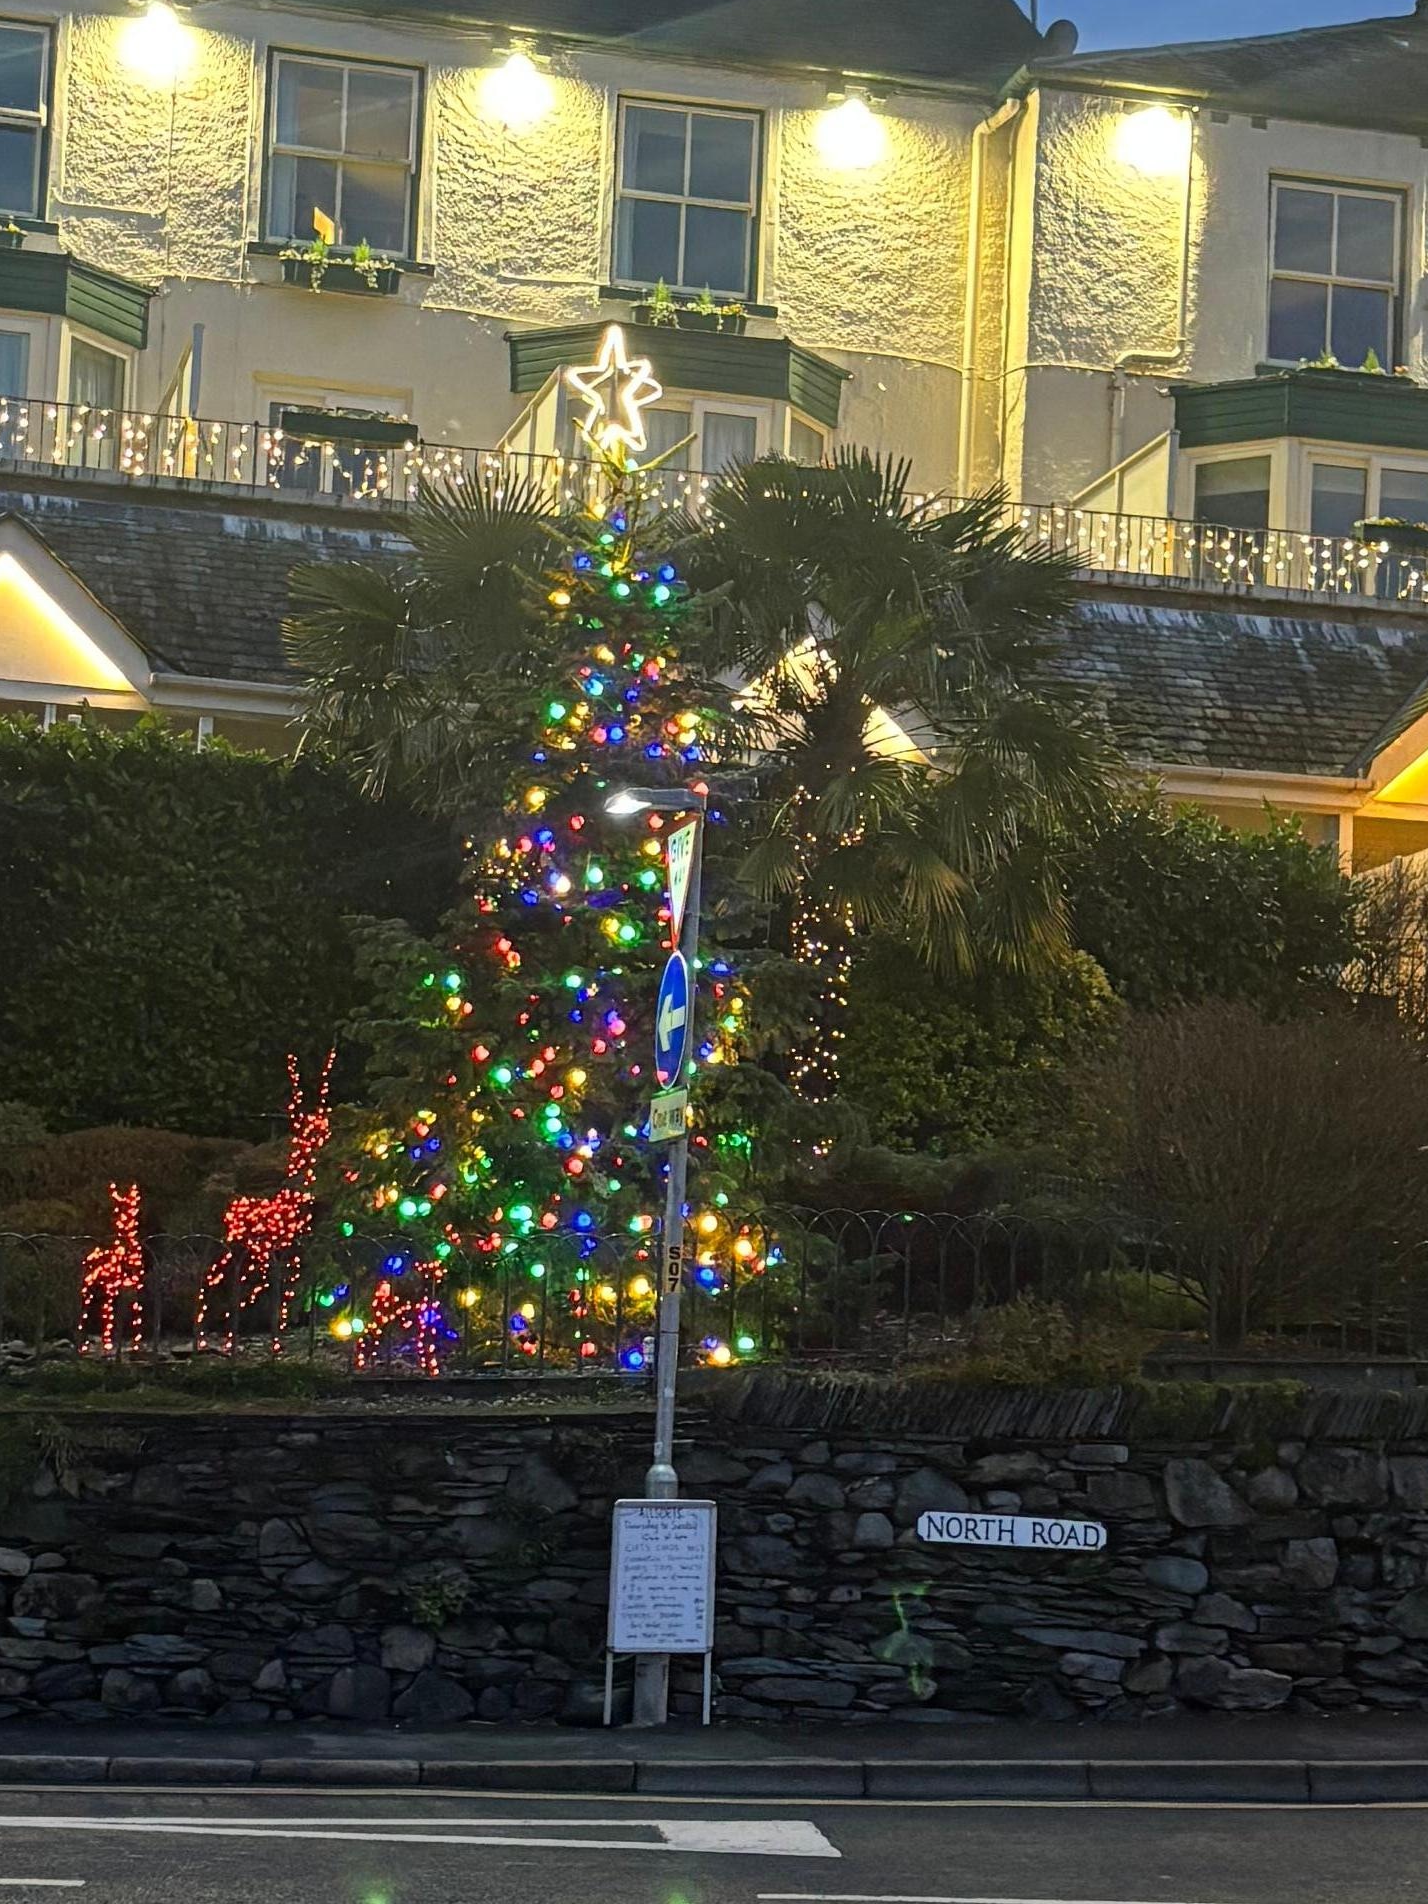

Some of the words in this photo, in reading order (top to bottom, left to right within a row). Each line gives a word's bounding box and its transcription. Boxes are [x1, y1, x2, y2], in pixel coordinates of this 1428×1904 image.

[668, 1246, 681, 1292] S07
[925, 1514, 1016, 1545] NORTH
[1030, 1521, 1101, 1549] ROAD
